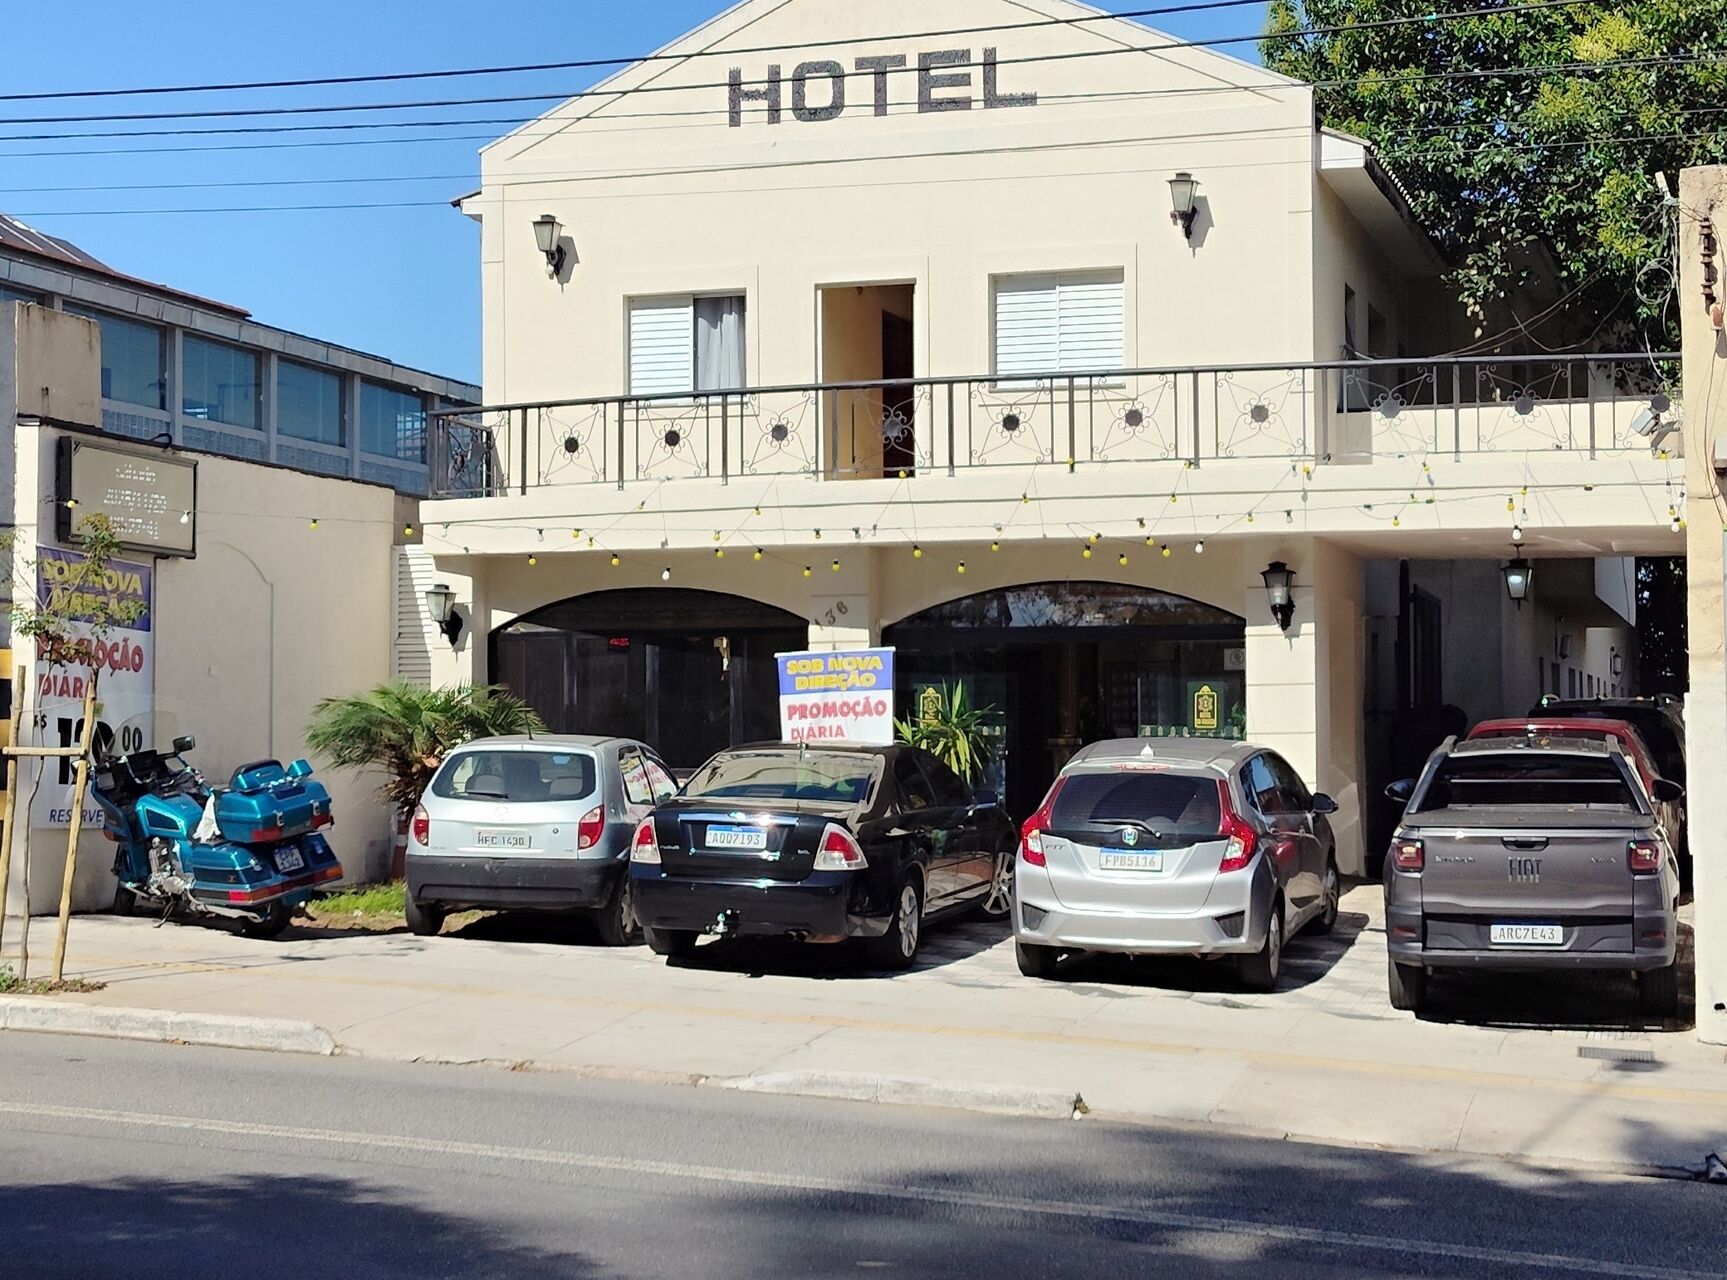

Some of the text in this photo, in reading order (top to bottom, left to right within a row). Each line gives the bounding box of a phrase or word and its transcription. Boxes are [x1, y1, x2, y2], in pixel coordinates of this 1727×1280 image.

[728, 47, 1037, 127] HOTEL
[787, 656, 883, 675] SOB NOVA
[795, 671, 876, 691] DIREÇÃO
[787, 696, 887, 721] PROMOÇÃO
[791, 723, 845, 740] DIÁRIA
[49, 808, 104, 823] RESRVE
[1508, 856, 1542, 882] FIAT
[1499, 927, 1555, 940] ARC7E43
